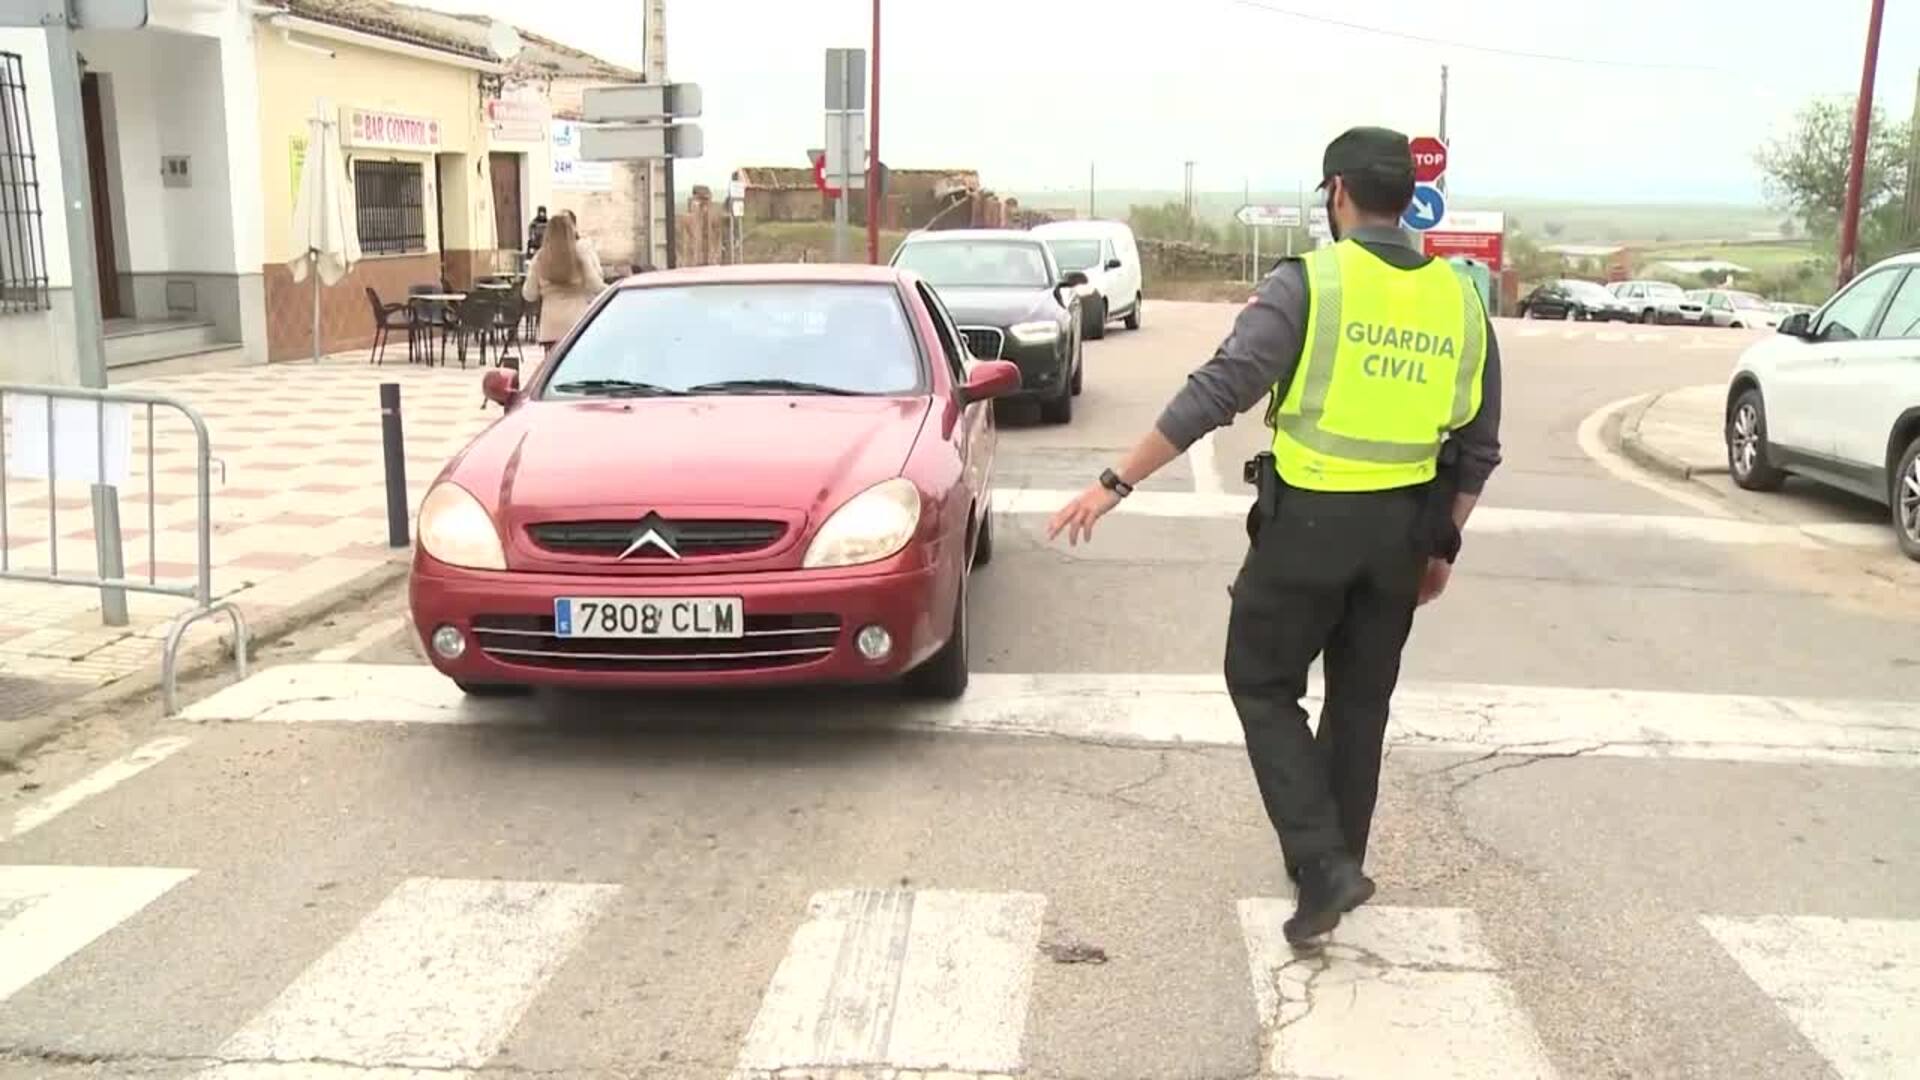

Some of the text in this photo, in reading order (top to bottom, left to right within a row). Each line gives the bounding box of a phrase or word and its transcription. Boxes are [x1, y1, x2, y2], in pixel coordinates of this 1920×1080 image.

[364, 114, 427, 145] BAR CONTROL
[554, 160, 573, 173] 24H
[1414, 152, 1445, 166] TOP
[1346, 321, 1455, 359] GUARDIA
[1362, 354, 1428, 385] CIVIL
[671, 603, 734, 634] CLM
